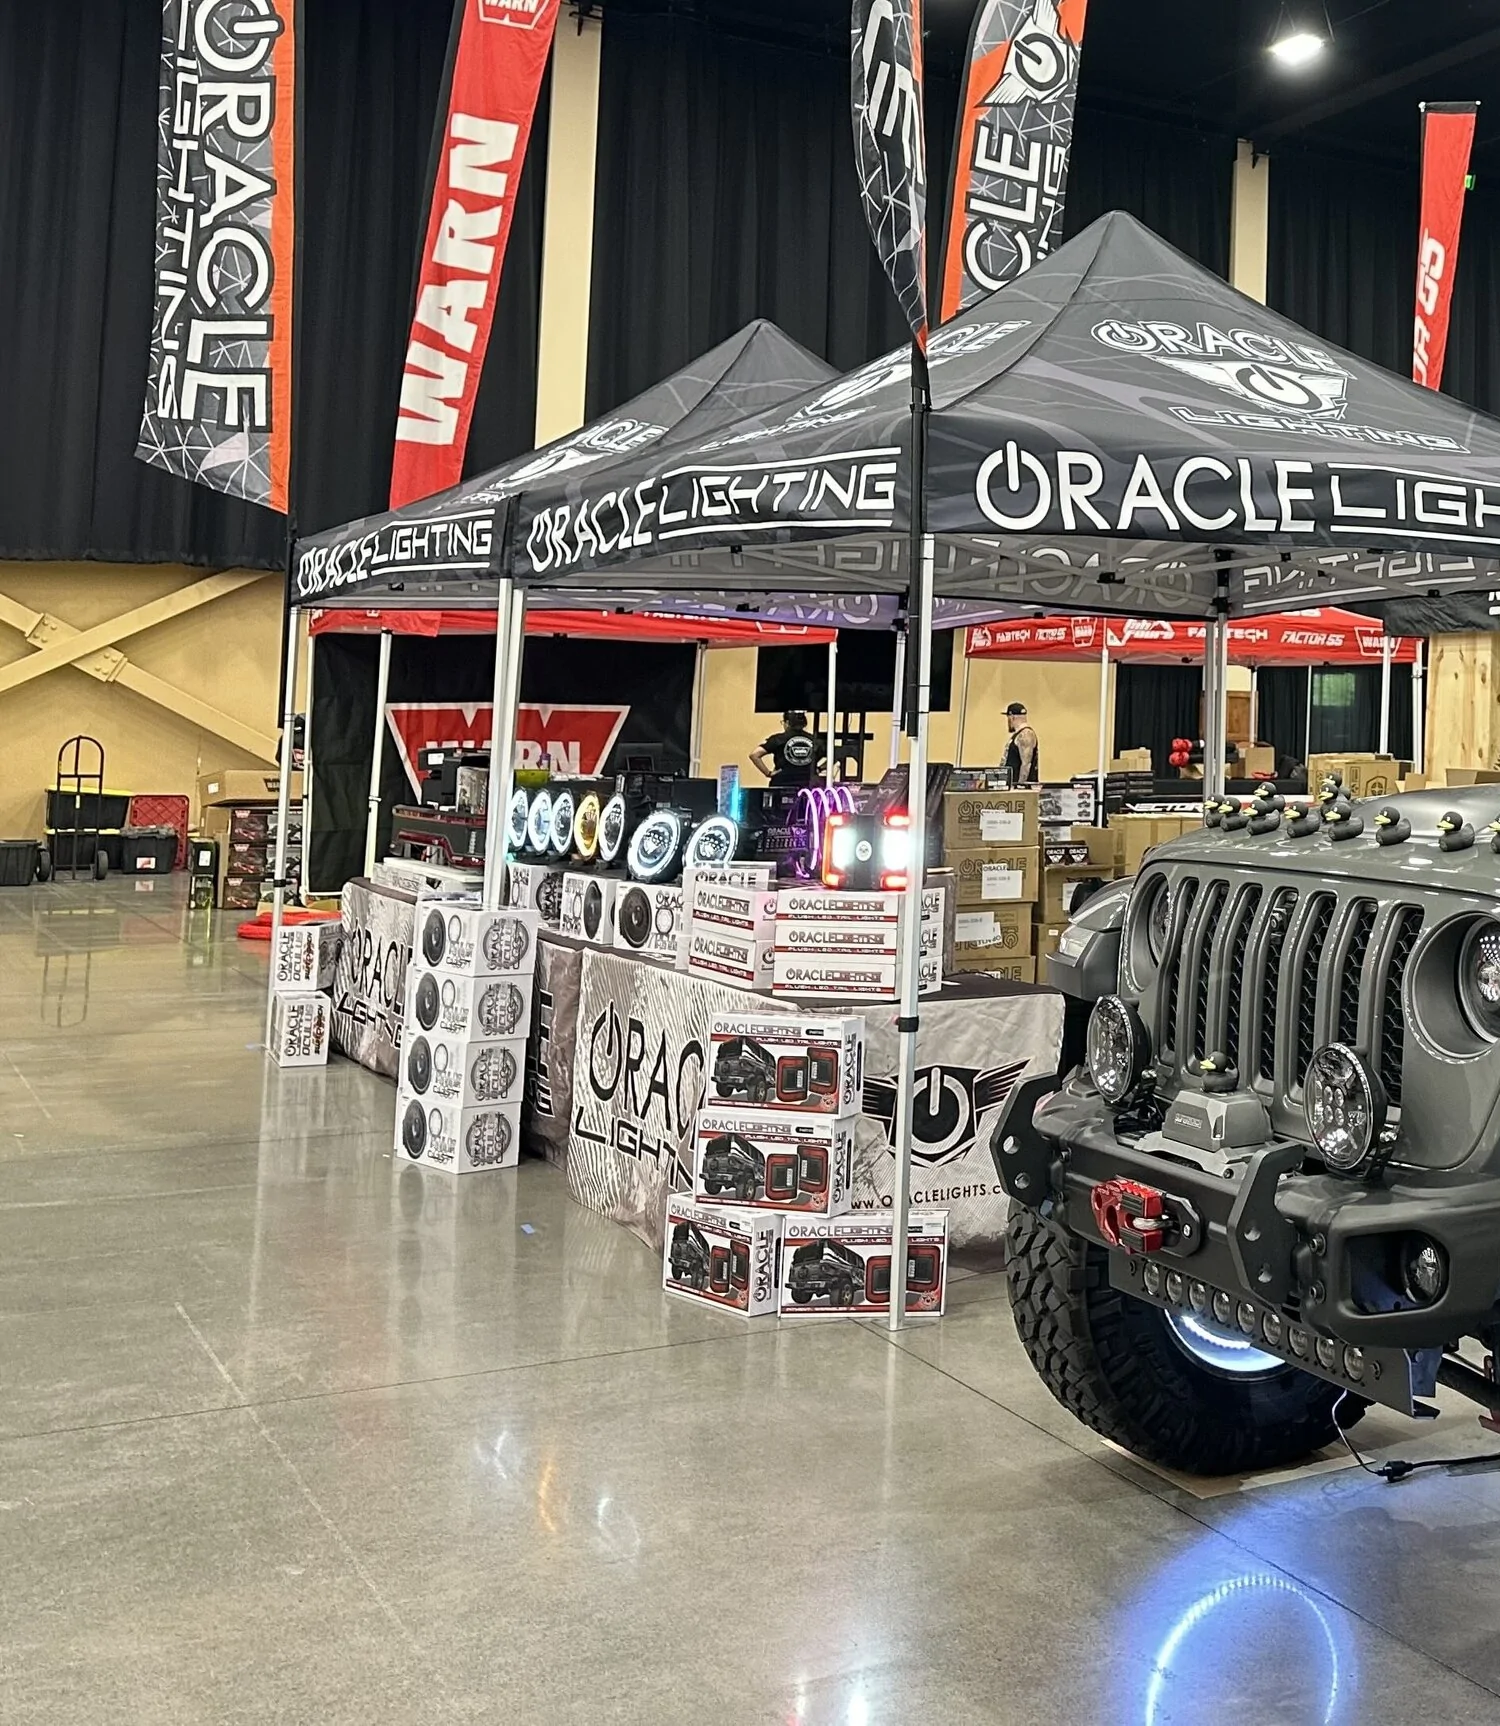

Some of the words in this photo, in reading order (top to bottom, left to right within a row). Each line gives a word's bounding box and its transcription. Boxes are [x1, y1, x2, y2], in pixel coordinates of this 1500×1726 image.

[183, 0, 278, 427] ORACLE
[395, 112, 519, 446] WARN
[1091, 318, 1356, 382] ORACLE
[1168, 405, 1470, 453] LIGHTING
[976, 440, 1314, 533] ORACLE
[371, 520, 492, 564] LIGHTING
[527, 476, 657, 573] ORACLE
[658, 462, 896, 526] LIGHTING
[1187, 626, 1268, 643] FATECH
[1125, 802, 1203, 812] VECTOR
[789, 898, 831, 911] ORACLE
[277, 932, 289, 981] ORACLE
[293, 932, 303, 981] OCULUS
[789, 931, 831, 944] ORACLE
[786, 968, 832, 982] ORACLE
[284, 1005, 297, 1056] ORACLE
[302, 1004, 313, 1056] OCULUS
[714, 1022, 757, 1035] ORACLE
[844, 1033, 853, 1105] ORACLE
[703, 1119, 745, 1131] ORACLE
[833, 1132, 843, 1204] ORACLE
[671, 1204, 699, 1219] ORACLE
[789, 1225, 841, 1238] ORACLE
[754, 1230, 768, 1302] ORACLE
